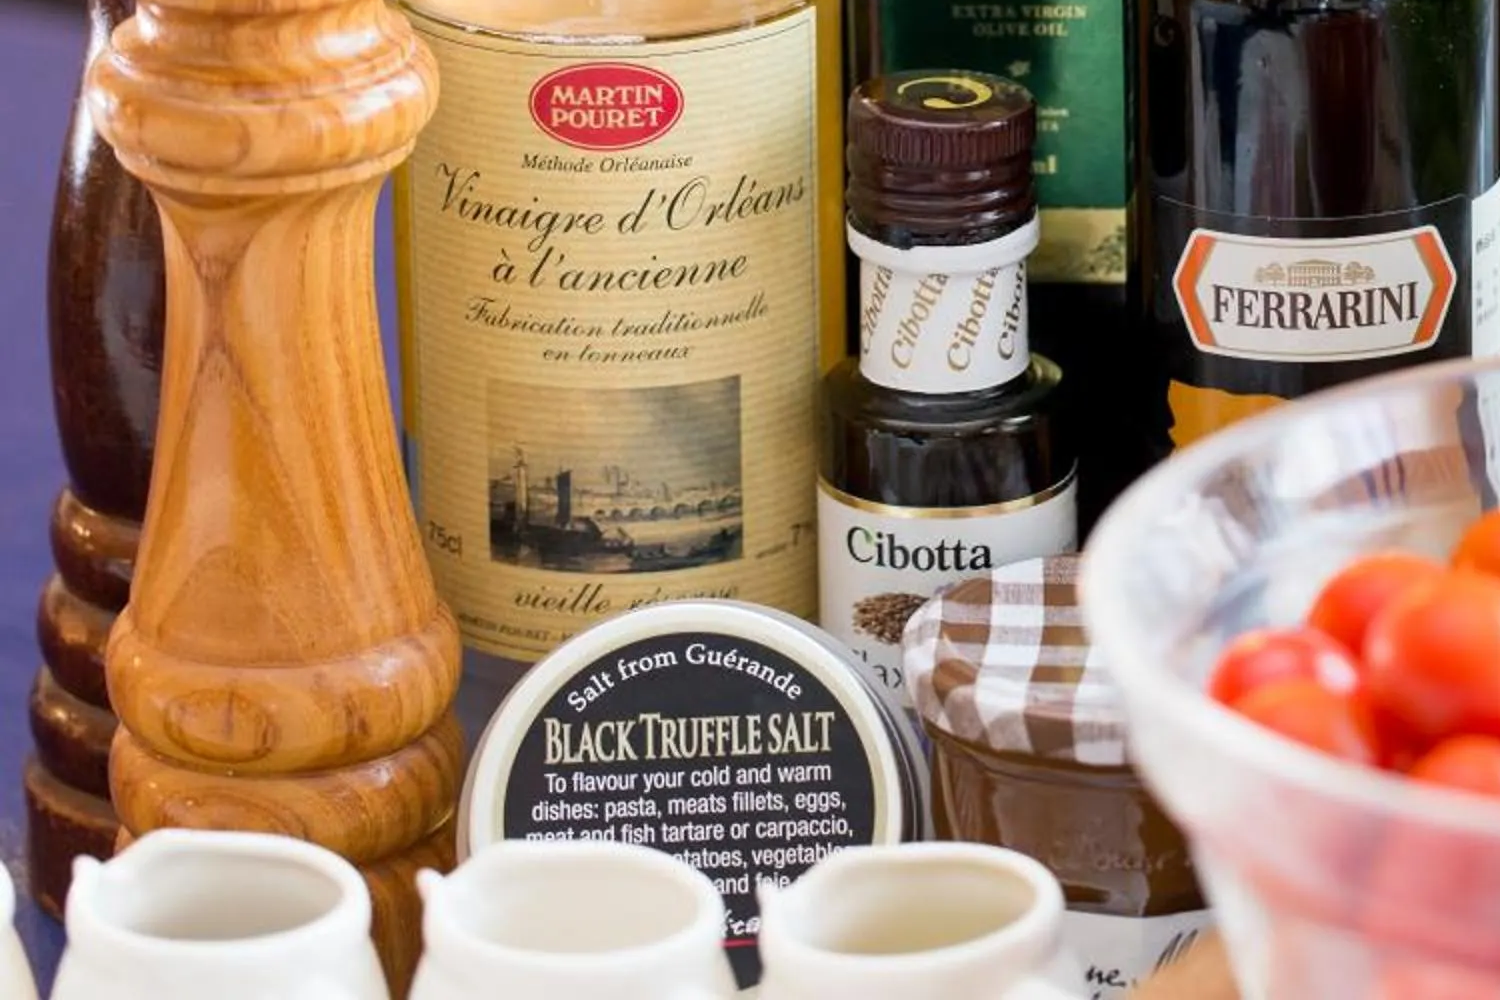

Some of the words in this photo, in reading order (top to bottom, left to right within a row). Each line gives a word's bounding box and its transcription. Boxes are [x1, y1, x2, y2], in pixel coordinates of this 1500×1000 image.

[952, 4, 1016, 18] EXTRA
[1021, 4, 1087, 18] VIRGIN
[972, 22, 1029, 37] OLIVE
[1033, 22, 1068, 37] OIL
[550, 83, 664, 107] MARTIN
[551, 107, 665, 130] POURET
[521, 153, 593, 173] Méthode
[599, 153, 693, 173] Orléanaise
[434, 163, 605, 251] Vinaigre
[617, 175, 805, 235] d'Orléans
[491, 248, 516, 285] à
[529, 246, 749, 292] l'ancienne
[464, 297, 604, 338] Fabrication
[611, 291, 769, 338] traditionnelle
[891, 272, 950, 370] Cibotta
[946, 267, 1000, 372] Cibotta
[1211, 280, 1419, 330] FERRARINI
[543, 348, 571, 362] en
[577, 343, 693, 364] tonneaux
[846, 525, 993, 572] Cibotta
[514, 583, 611, 615] vieille
[567, 671, 615, 713] Salt
[616, 648, 679, 681] from
[685, 643, 802, 700] Guérande
[543, 717, 637, 765] BLACK
[639, 712, 762, 759] TRUFFLE
[767, 711, 835, 755] SALT
[544, 773, 567, 794] To
[572, 770, 637, 793] flavour
[643, 770, 685, 793] your
[690, 764, 730, 787] cold
[735, 763, 771, 784] and
[776, 764, 832, 783] warm
[531, 800, 599, 822] dishes:
[604, 797, 663, 823] pasta,
[667, 795, 727, 816] meats
[733, 790, 789, 814] fillets,
[795, 789, 847, 813] eggs,
[580, 824, 616, 842] and
[621, 823, 656, 845] fish
[661, 822, 726, 843] tartare
[730, 822, 750, 840] or
[755, 814, 854, 840] carpaccio,
[673, 847, 748, 870] otatoes,
[751, 842, 847, 869] vegetabl
[714, 873, 750, 895] and
